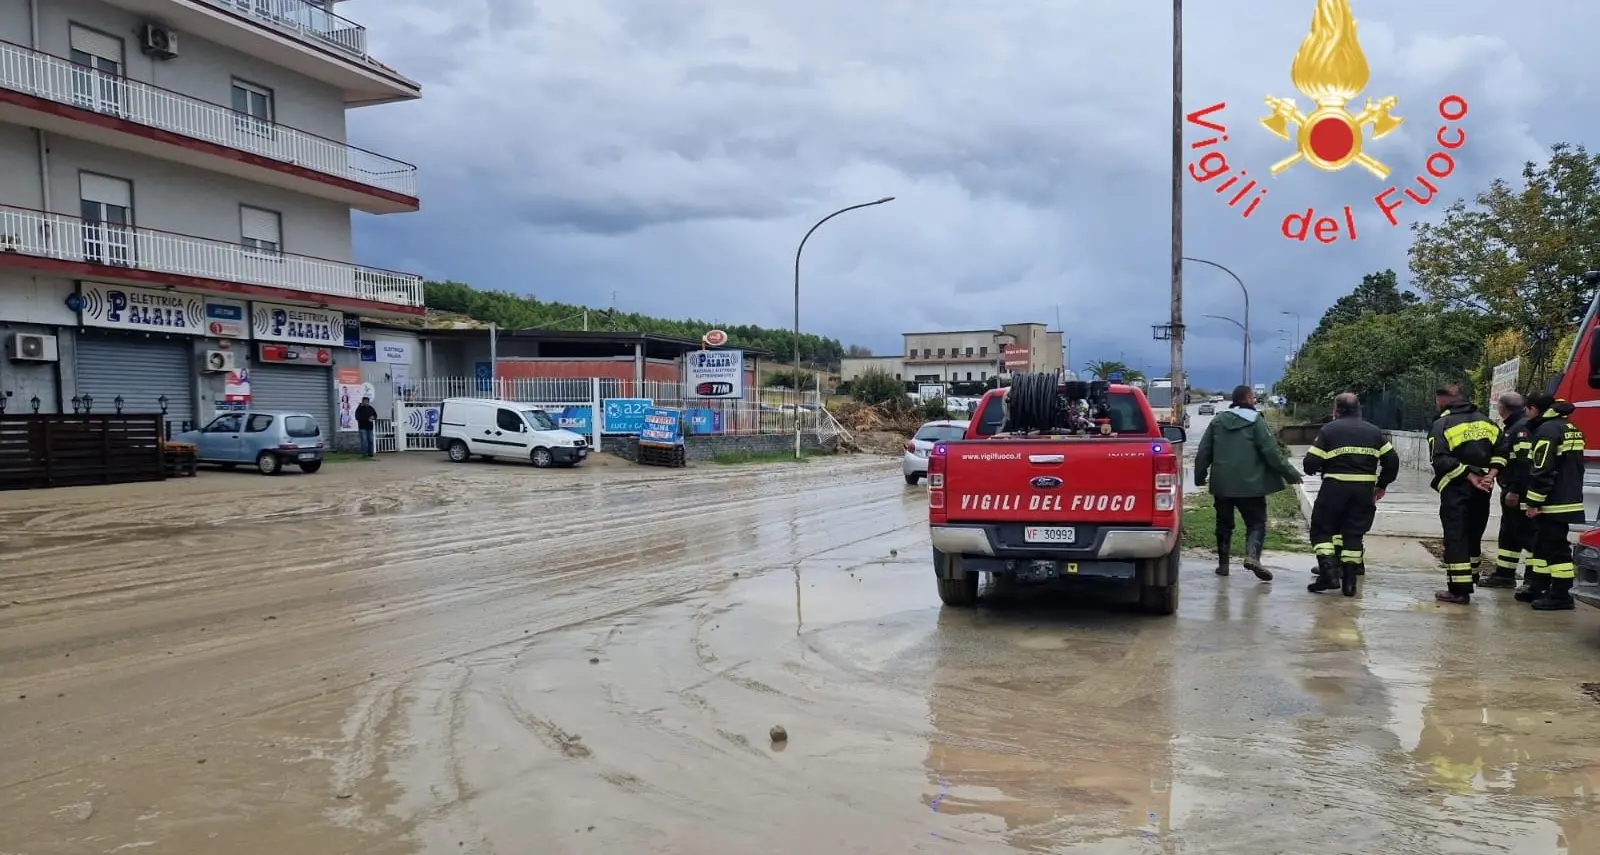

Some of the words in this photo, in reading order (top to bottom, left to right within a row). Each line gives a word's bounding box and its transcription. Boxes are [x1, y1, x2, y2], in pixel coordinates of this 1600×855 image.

[130, 292, 184, 308] ELETTRICA
[107, 290, 185, 328] PALAIA
[288, 310, 329, 322] ELETTRICA
[271, 308, 330, 341] PALAIA
[712, 384, 730, 394] TIM
[962, 453, 1021, 461] www.vigilfuoco.it
[1036, 477, 1056, 487] Ford
[961, 494, 1021, 510] VIGILI
[1028, 495, 1063, 511] DEL
[1071, 495, 1136, 512] FUOCO
[1027, 528, 1038, 539] VF
[1044, 529, 1073, 540] 30992
